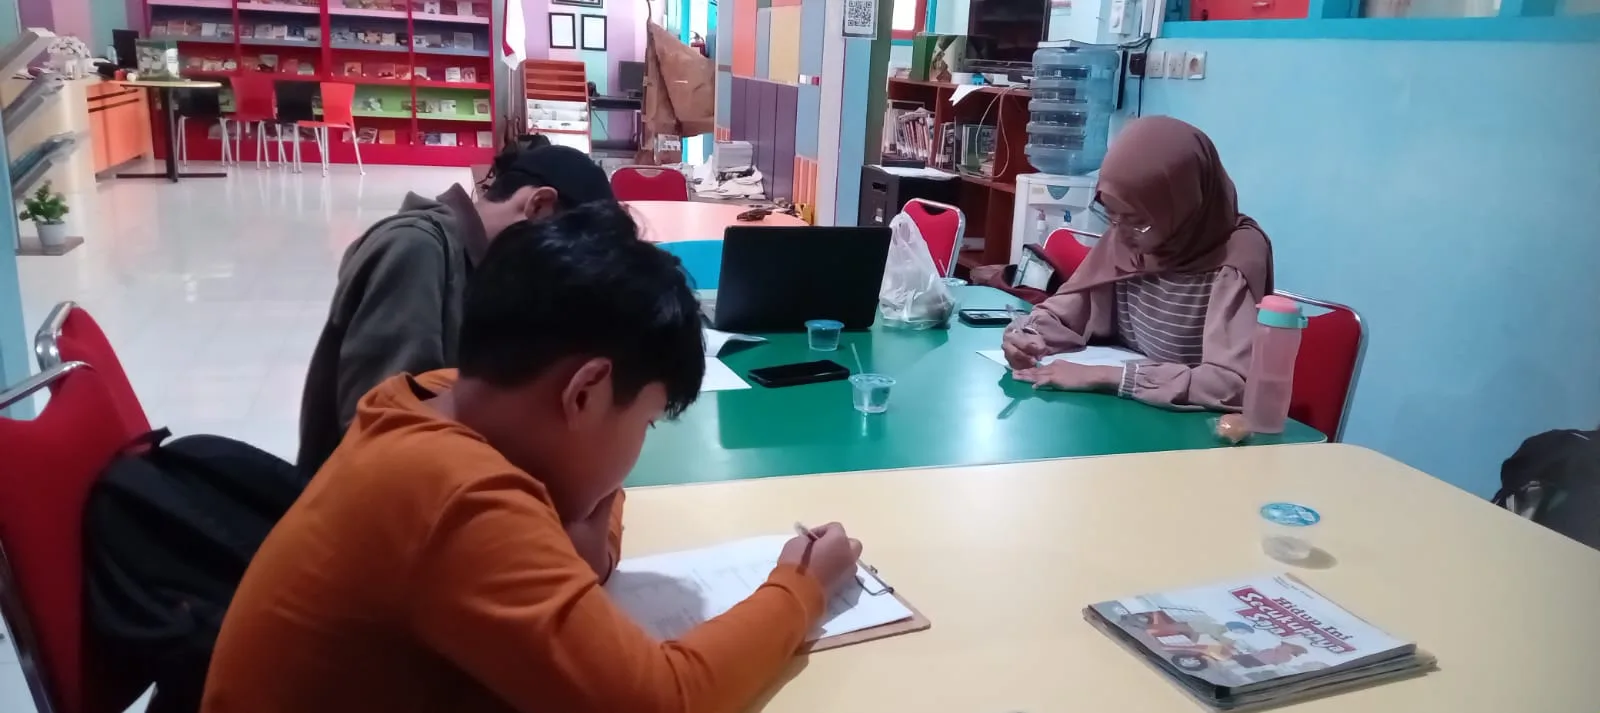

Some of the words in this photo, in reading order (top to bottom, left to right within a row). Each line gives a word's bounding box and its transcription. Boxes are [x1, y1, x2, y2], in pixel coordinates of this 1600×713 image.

[1239, 592, 1345, 654] Secukupnya
[1246, 612, 1287, 637] Saja
[1272, 597, 1322, 626] Hidup
[1322, 626, 1354, 641] Ini
